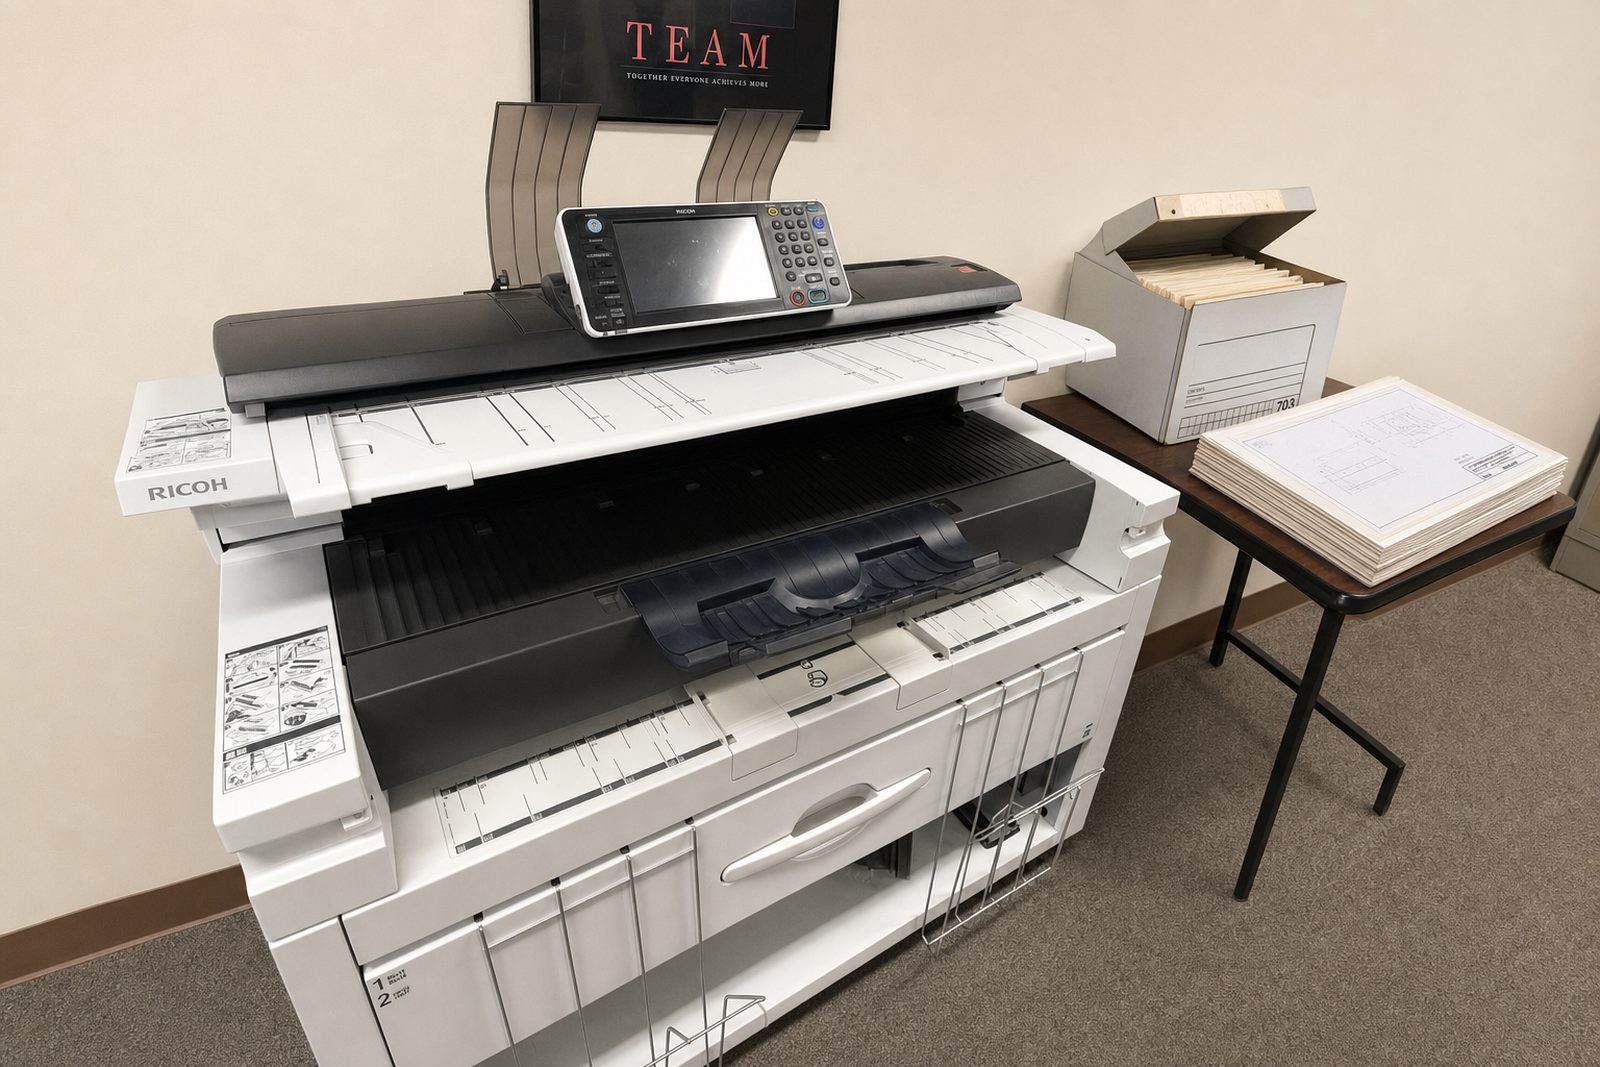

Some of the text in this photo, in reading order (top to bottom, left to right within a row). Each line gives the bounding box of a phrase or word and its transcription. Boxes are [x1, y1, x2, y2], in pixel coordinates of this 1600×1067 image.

[626, 21, 771, 70] TEAM
[626, 72, 769, 88] TOGETHER EVERYONE ACHIEVES MORE
[1276, 398, 1296, 412] 703
[147, 477, 228, 501] RICOH
[372, 978, 384, 991] 1
[377, 992, 392, 1008] 2
